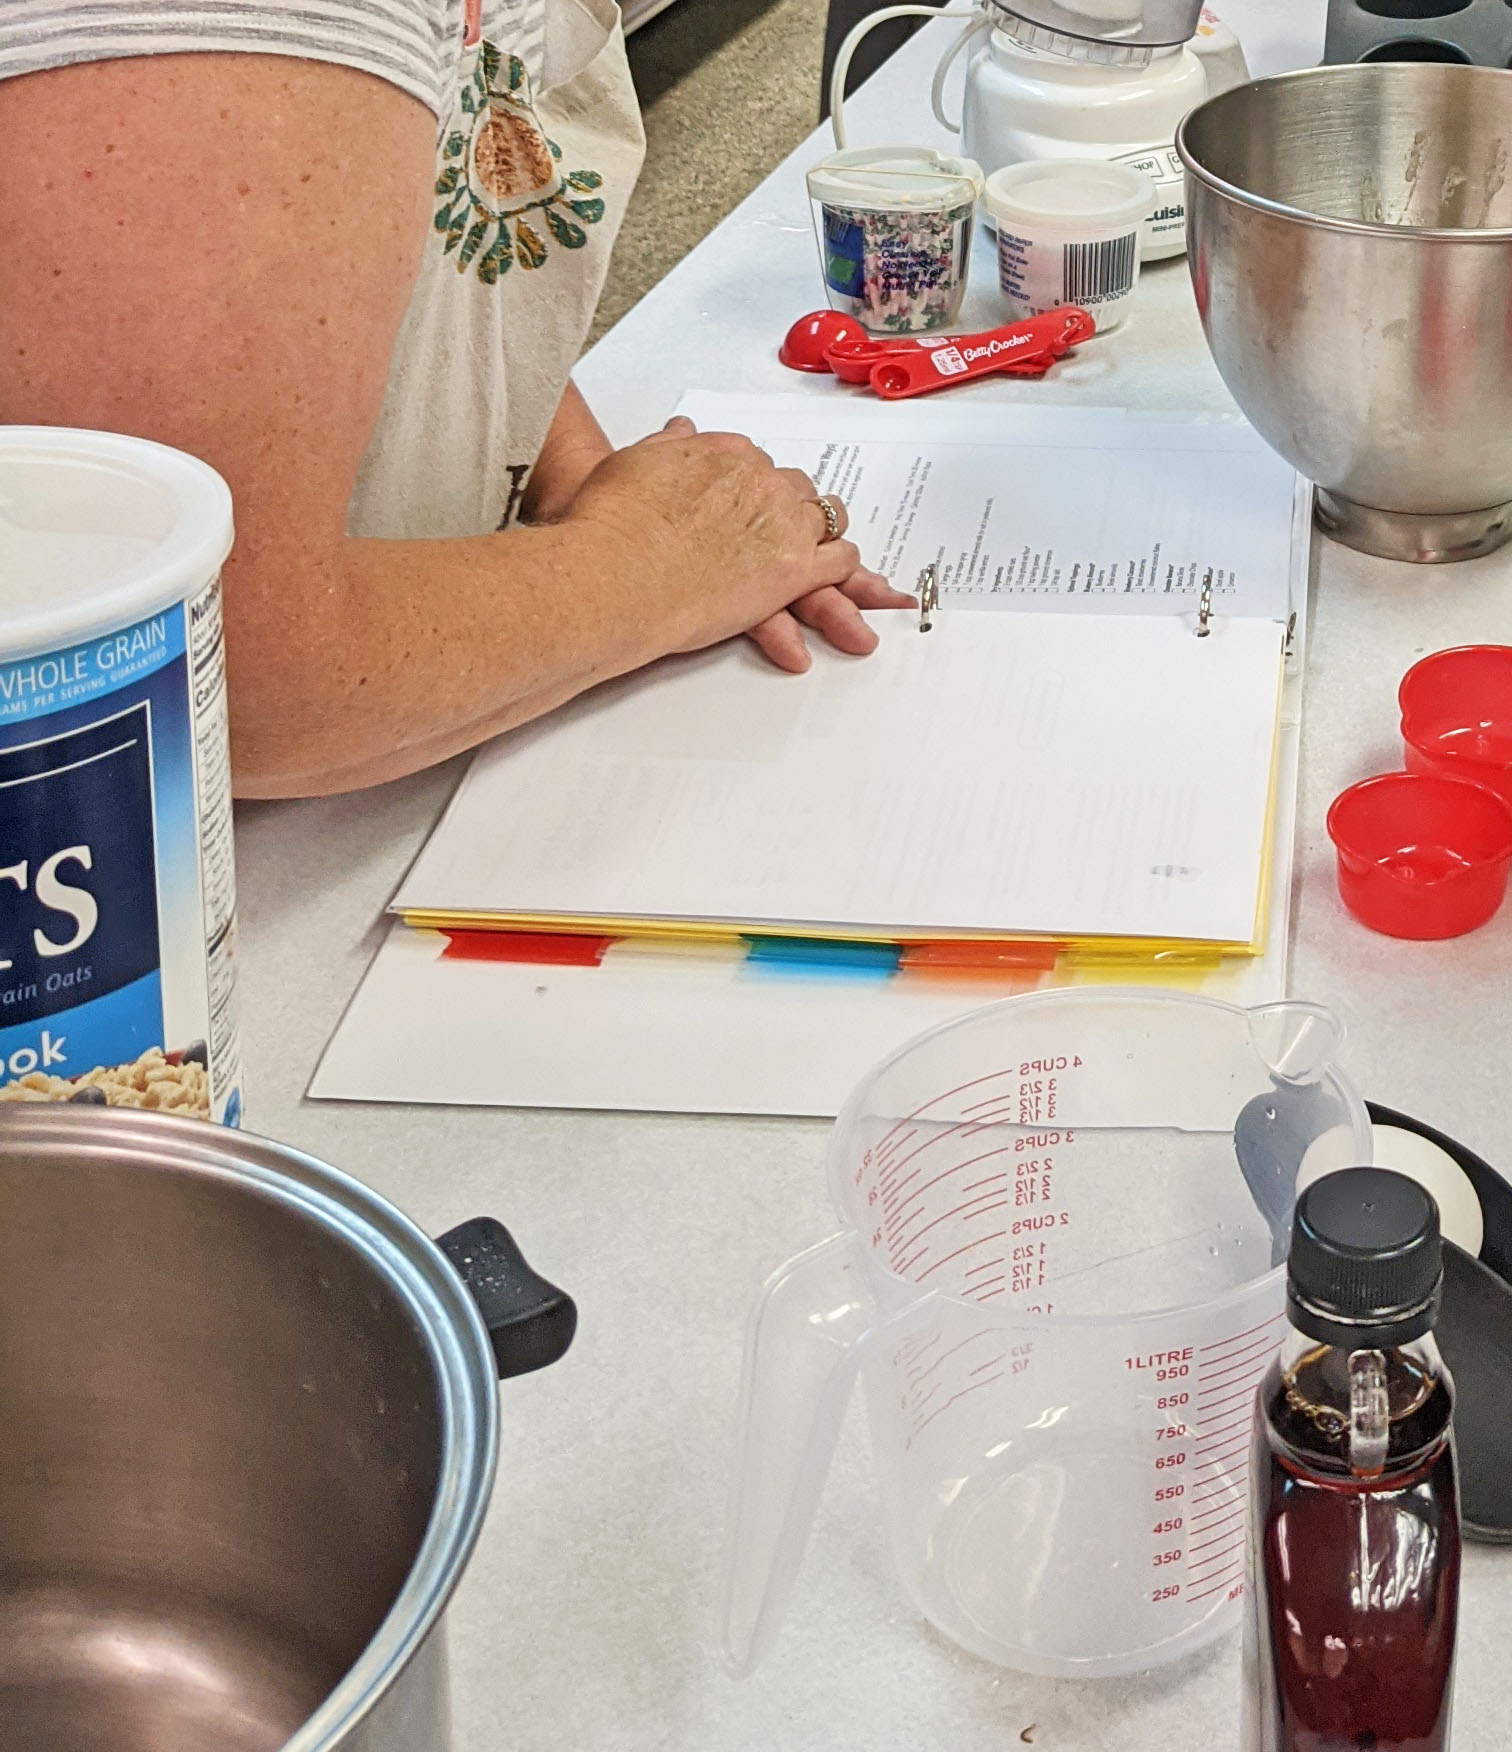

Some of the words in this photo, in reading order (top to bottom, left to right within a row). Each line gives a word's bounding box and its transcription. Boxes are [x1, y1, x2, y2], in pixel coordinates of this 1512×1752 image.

[96, 617, 166, 670] GRAIN
[2, 699, 27, 715] AMS
[34, 691, 55, 708] PER
[60, 673, 105, 701] SERVING
[109, 646, 167, 681] GUARANTEED
[46, 965, 93, 992] Oats
[1156, 1364, 1189, 1381] 950
[1157, 1393, 1189, 1409] 850
[1155, 1424, 1186, 1441] 750
[1155, 1452, 1185, 1469] 650
[1154, 1484, 1184, 1501] 550
[1152, 1517, 1183, 1534] 450
[1153, 1550, 1181, 1566] 350
[1152, 1584, 1180, 1602] 250
